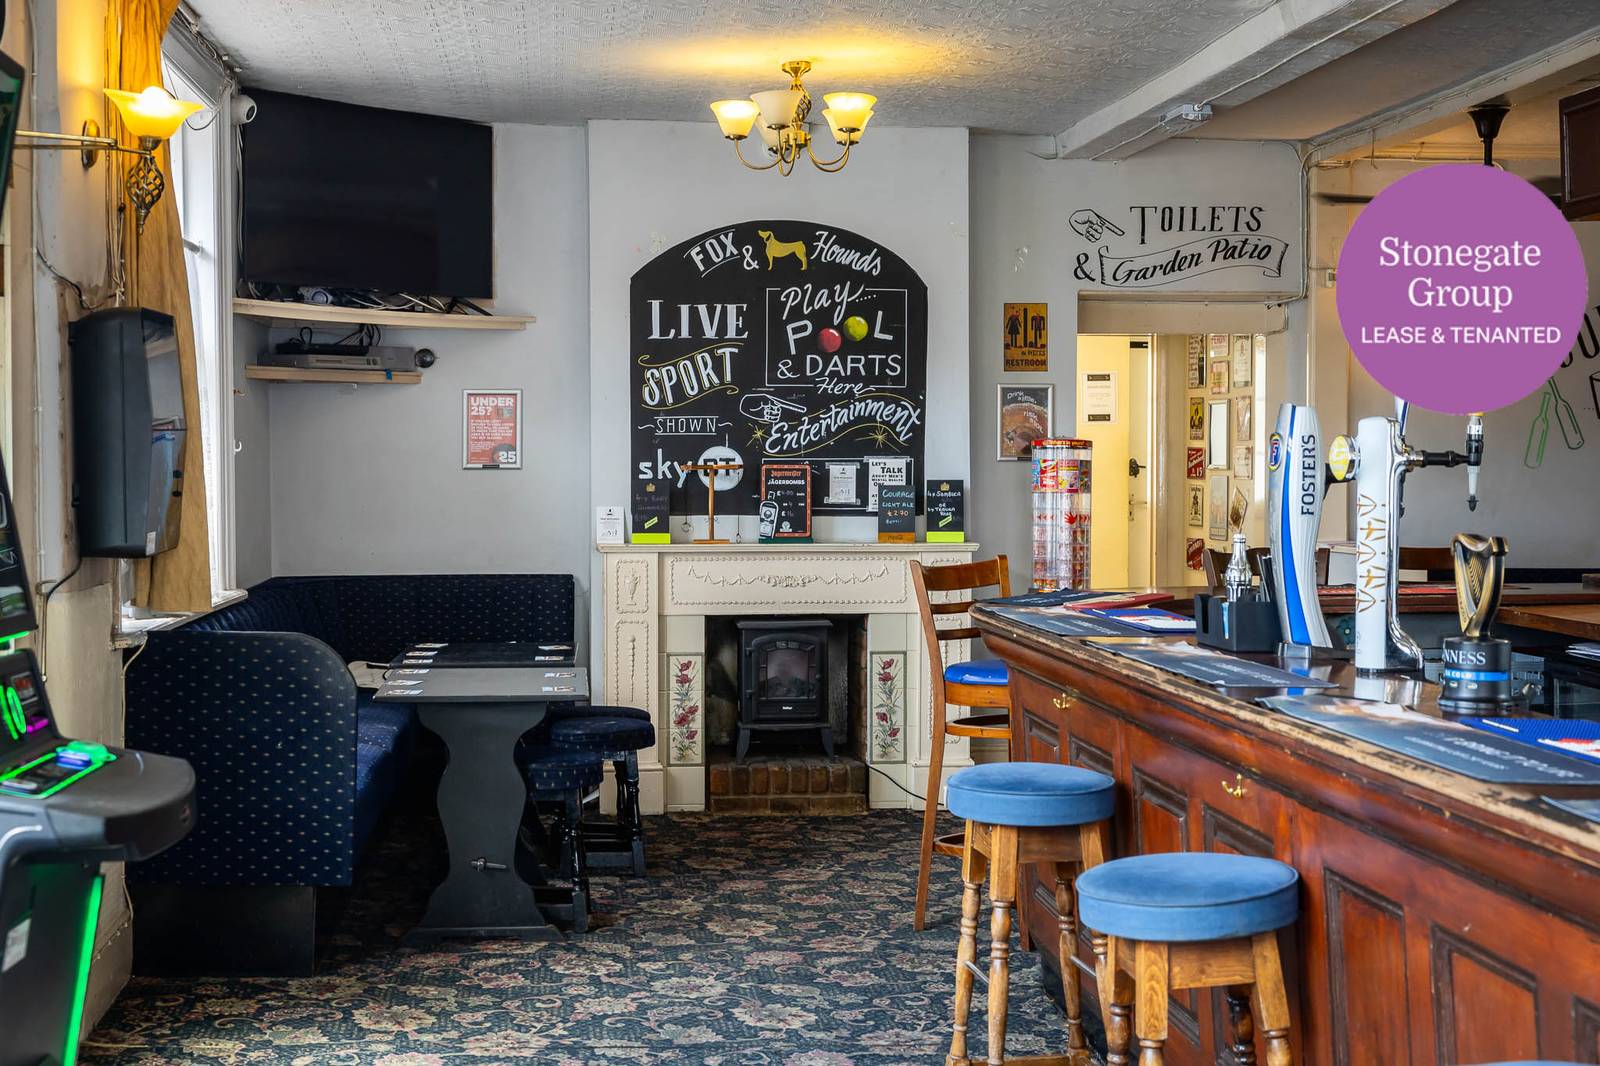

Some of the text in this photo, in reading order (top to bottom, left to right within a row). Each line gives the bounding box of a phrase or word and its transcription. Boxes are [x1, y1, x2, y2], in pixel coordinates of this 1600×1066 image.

[1130, 205, 1265, 245] TOILETS
[691, 231, 881, 276] FOX & Hounds
[1073, 238, 1272, 285] & Garden Patio
[647, 299, 749, 340] LIVE
[777, 353, 902, 379] & DARTS
[1006, 358, 1047, 367] RESTROOM
[643, 347, 738, 406] SPORT
[815, 376, 876, 396] Here
[471, 396, 514, 407] UNDER
[471, 406, 492, 416] 25?
[656, 418, 717, 433] SHOWN
[764, 398, 921, 454] Entertainment
[499, 451, 516, 463] 25
[638, 448, 693, 488] sky
[880, 466, 904, 474] TALK
[1301, 434, 1316, 516] FOSTER'S
[882, 489, 915, 498] COURAGE
[1442, 648, 1486, 665] NNESS
